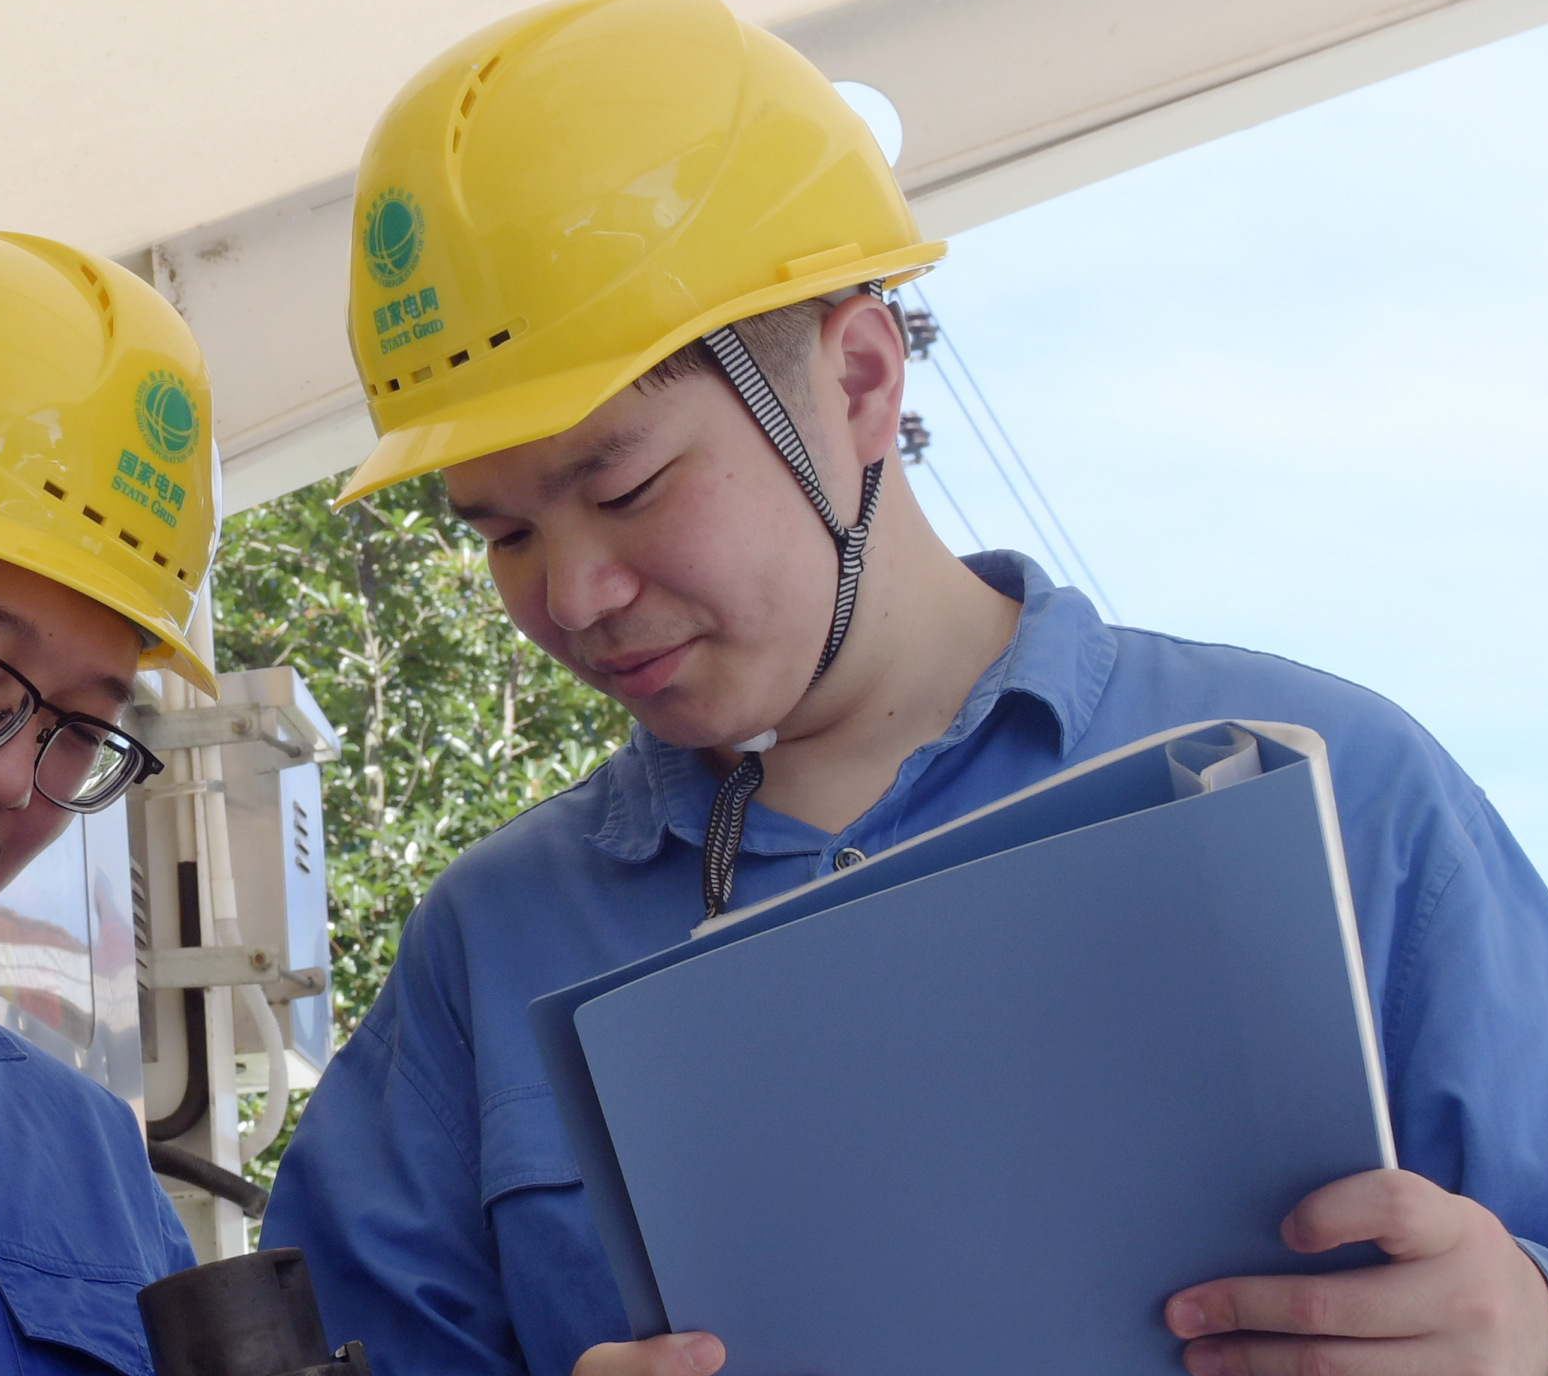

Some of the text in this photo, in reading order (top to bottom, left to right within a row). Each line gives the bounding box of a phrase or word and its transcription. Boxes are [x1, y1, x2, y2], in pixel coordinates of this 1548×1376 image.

[381, 318, 444, 355] STATE GRID
[111, 475, 177, 528] STATE GRID
[117, 448, 186, 511] 国家电网
